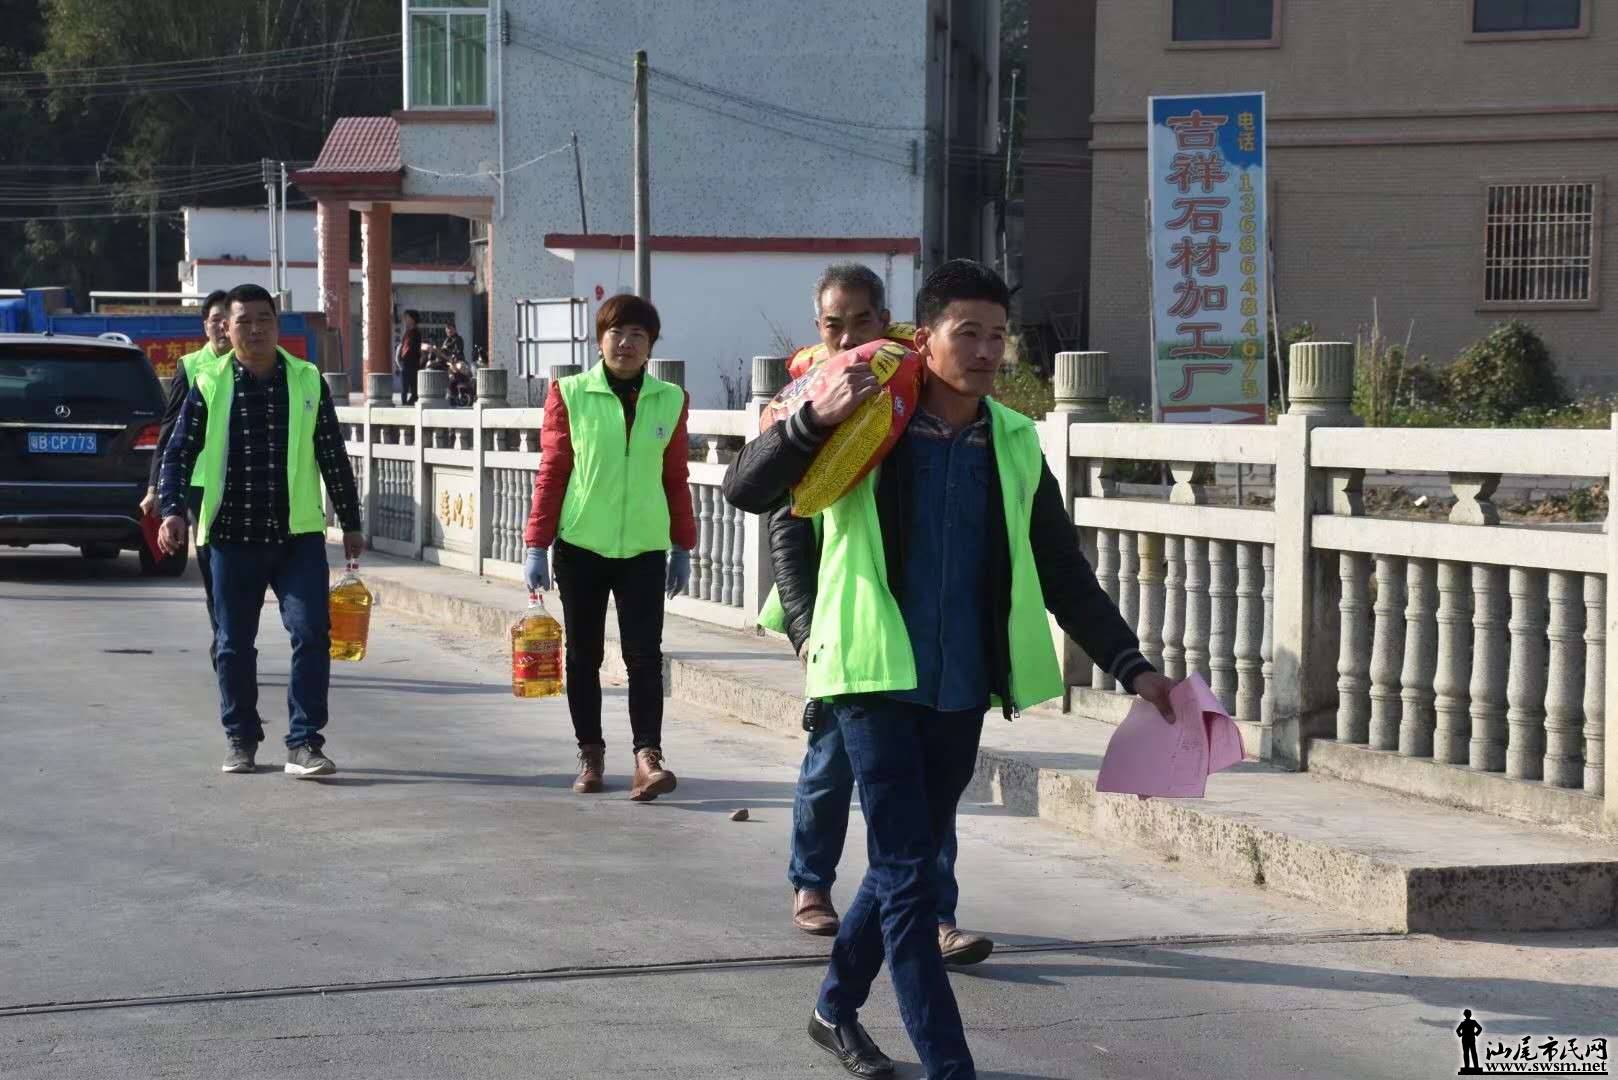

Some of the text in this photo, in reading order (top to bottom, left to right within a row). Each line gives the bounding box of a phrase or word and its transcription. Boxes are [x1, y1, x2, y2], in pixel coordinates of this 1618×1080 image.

[1237, 111, 1255, 152] 电话
[1165, 110, 1232, 401] 吉祥石材加工厂
